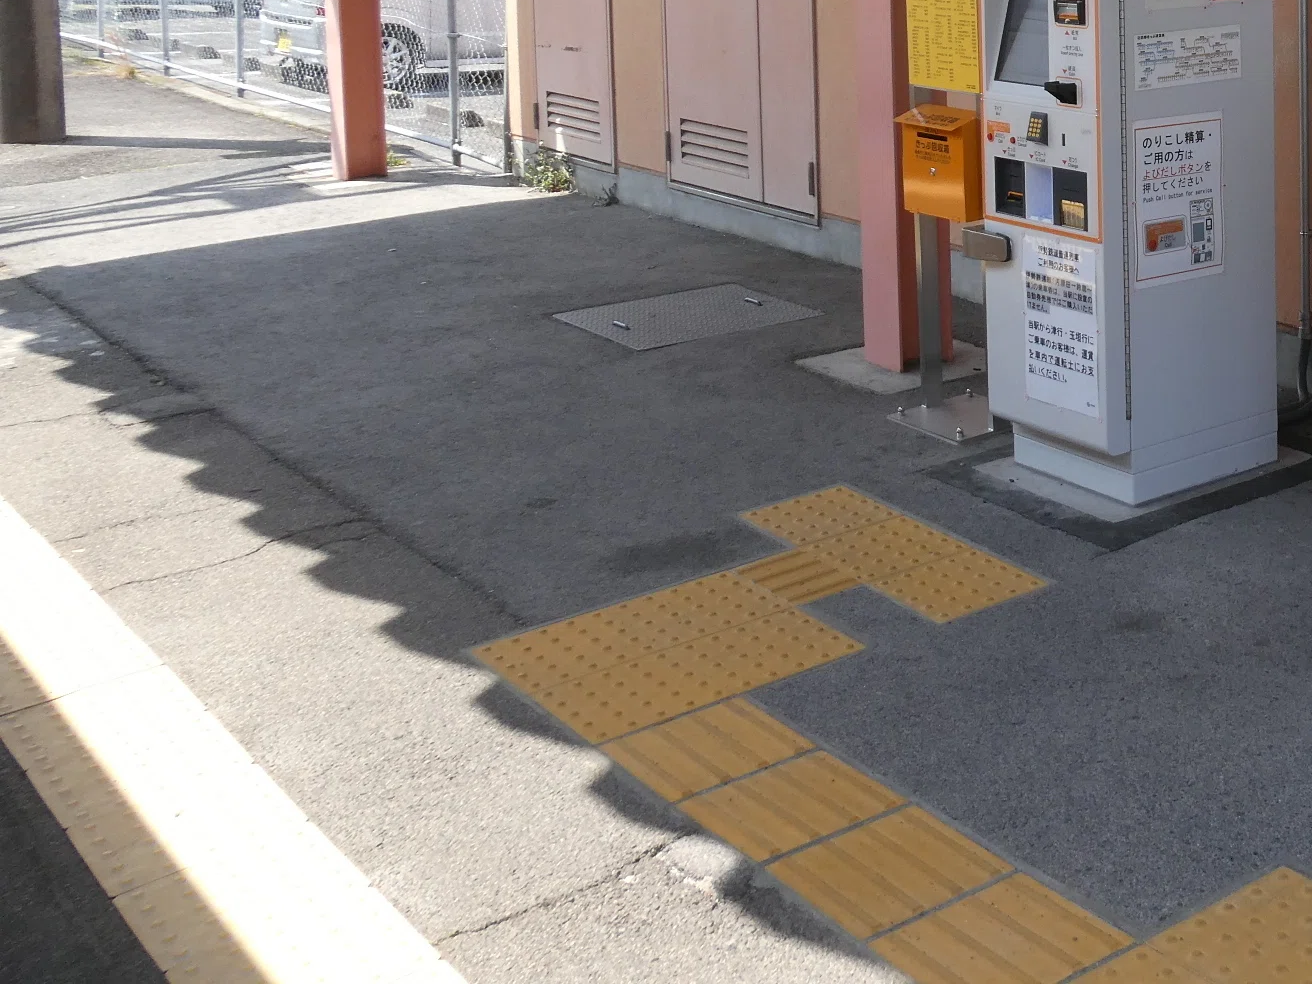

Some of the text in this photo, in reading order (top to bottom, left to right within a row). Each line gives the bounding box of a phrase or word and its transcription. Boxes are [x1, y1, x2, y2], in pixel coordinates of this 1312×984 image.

[1144, 149, 1194, 165] ご用の方は
[1143, 161, 1212, 180] よびだしボタンを
[1142, 176, 1203, 194] 押してください
